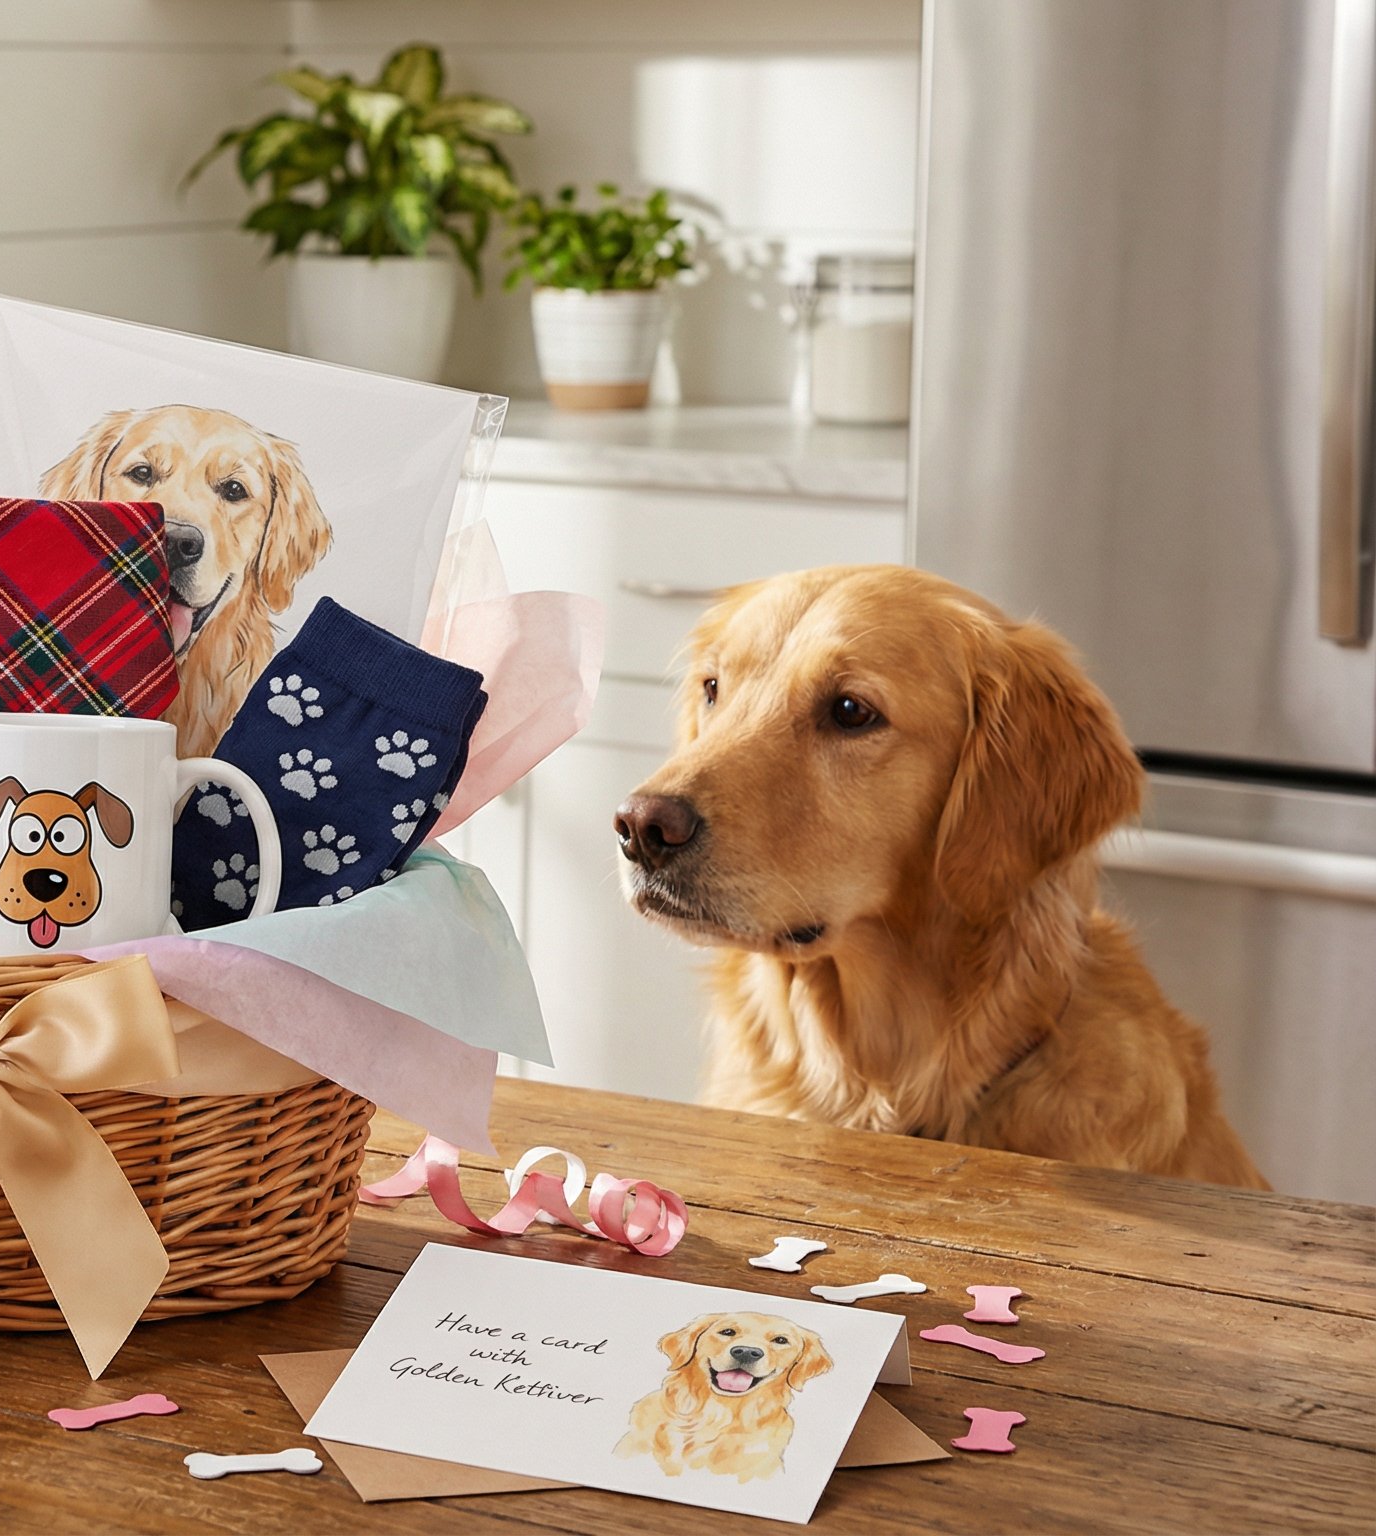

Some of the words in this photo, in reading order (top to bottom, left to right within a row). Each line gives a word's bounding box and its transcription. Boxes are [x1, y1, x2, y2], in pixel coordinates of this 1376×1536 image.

[434, 1312, 502, 1338] Have
[511, 1331, 528, 1342] a
[541, 1336, 609, 1355] card
[389, 1357, 485, 1388] Golden
[469, 1348, 532, 1366] with
